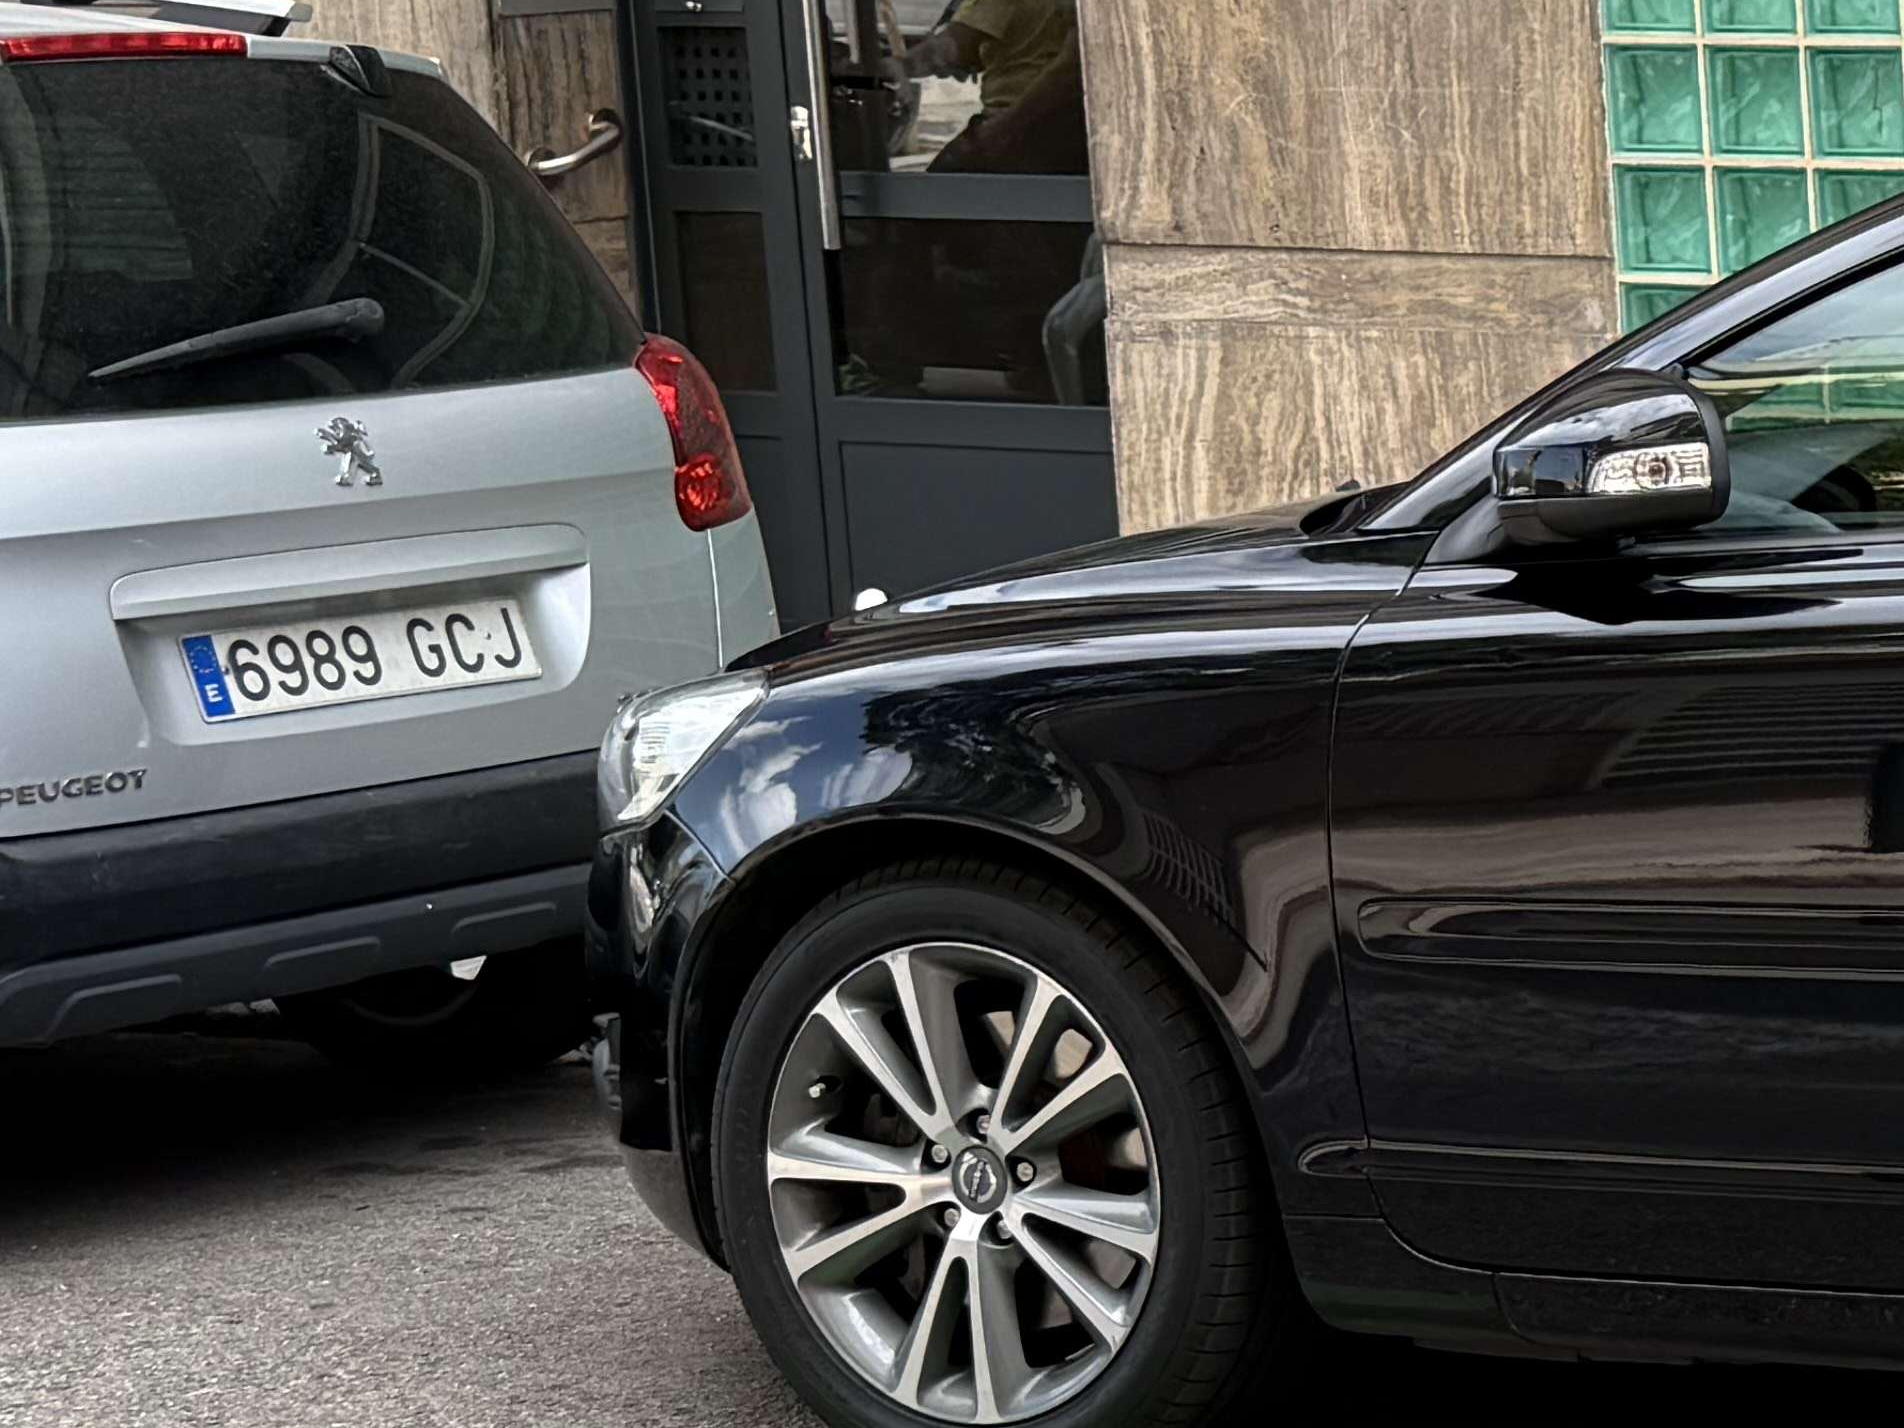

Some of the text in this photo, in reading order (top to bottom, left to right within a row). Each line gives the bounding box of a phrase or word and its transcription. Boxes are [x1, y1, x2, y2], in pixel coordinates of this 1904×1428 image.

[227, 607, 523, 702] 6989 GCJ
[203, 683, 223, 704] E
[0, 769, 148, 808] PEUGEOT
